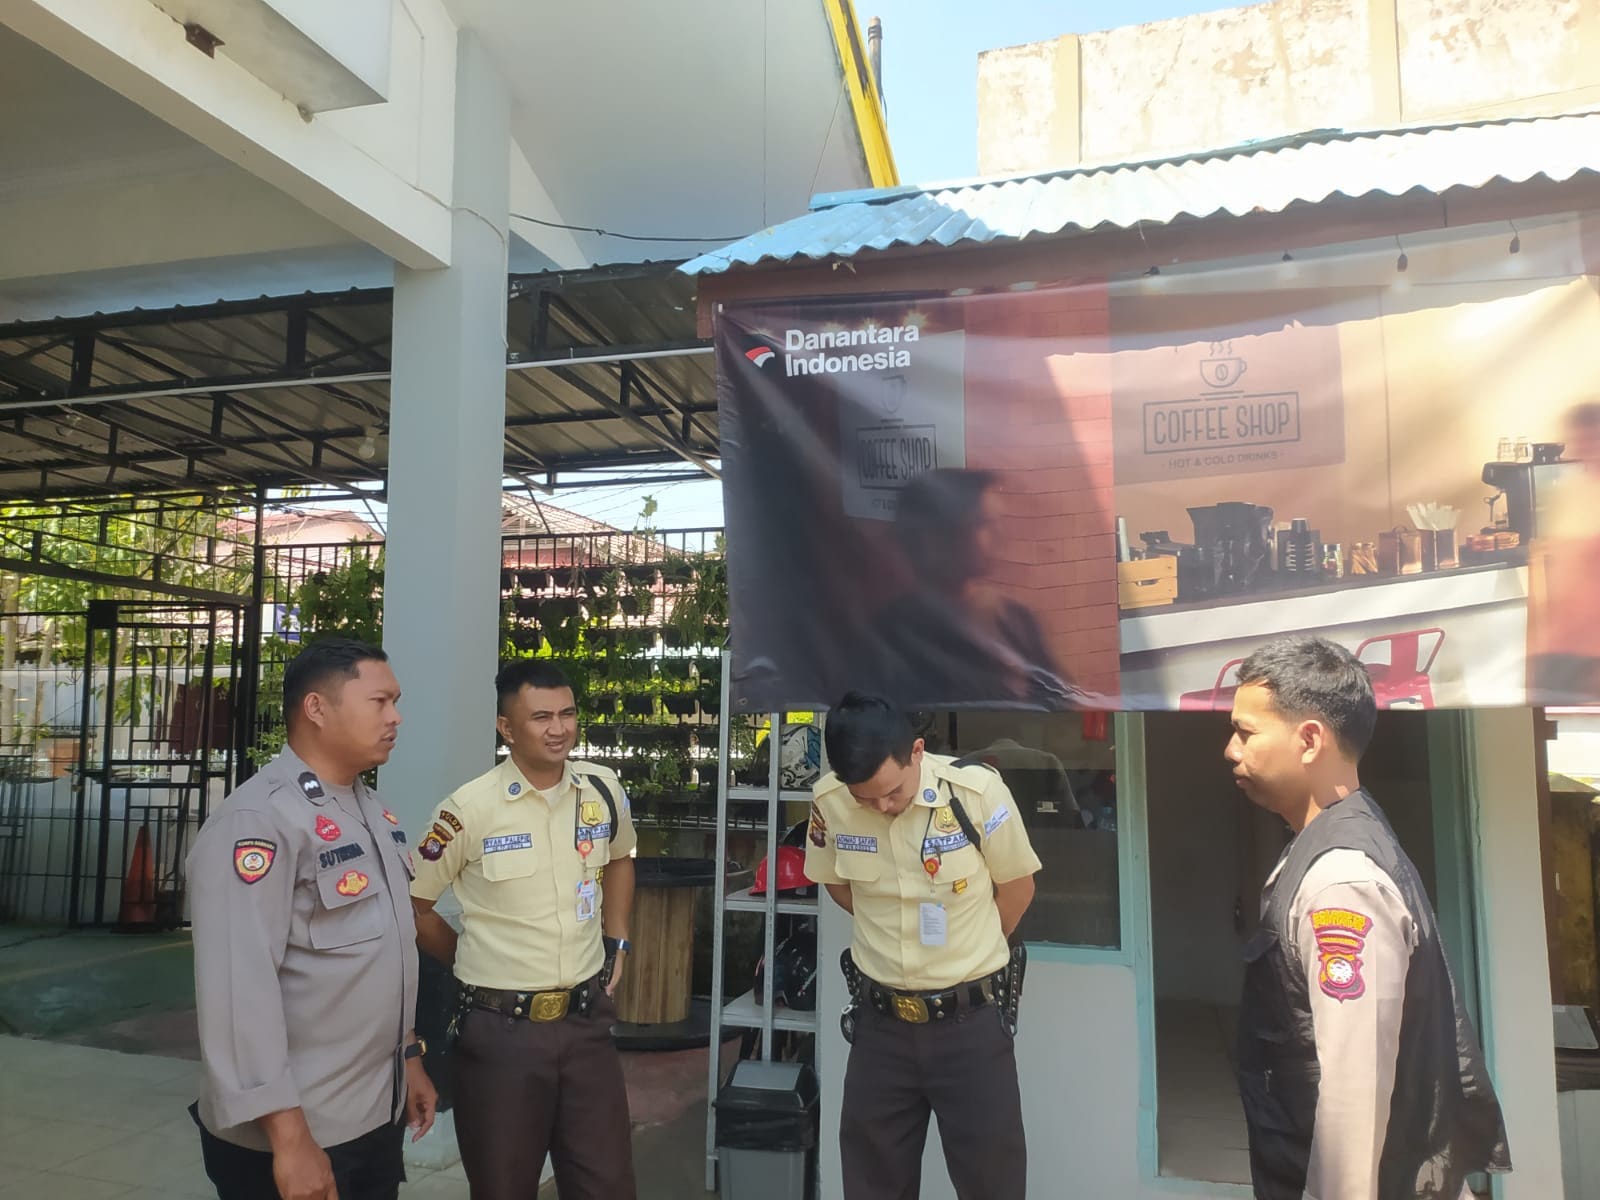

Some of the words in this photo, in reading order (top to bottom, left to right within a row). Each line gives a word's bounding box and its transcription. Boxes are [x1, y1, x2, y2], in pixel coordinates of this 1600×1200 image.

[785, 324, 920, 350] Danantara
[785, 346, 911, 377] Indonesia
[1153, 406, 1229, 445] COFFEE
[1236, 402, 1290, 439] SHOP
[861, 437, 898, 480] COFFEE
[900, 436, 931, 480] SHOP
[1168, 458, 1190, 469] HOT
[1204, 455, 1234, 466] COLD
[1238, 451, 1278, 463] DRINKS
[441, 812, 461, 831] POLDA
[927, 832, 966, 848] SATPAM
